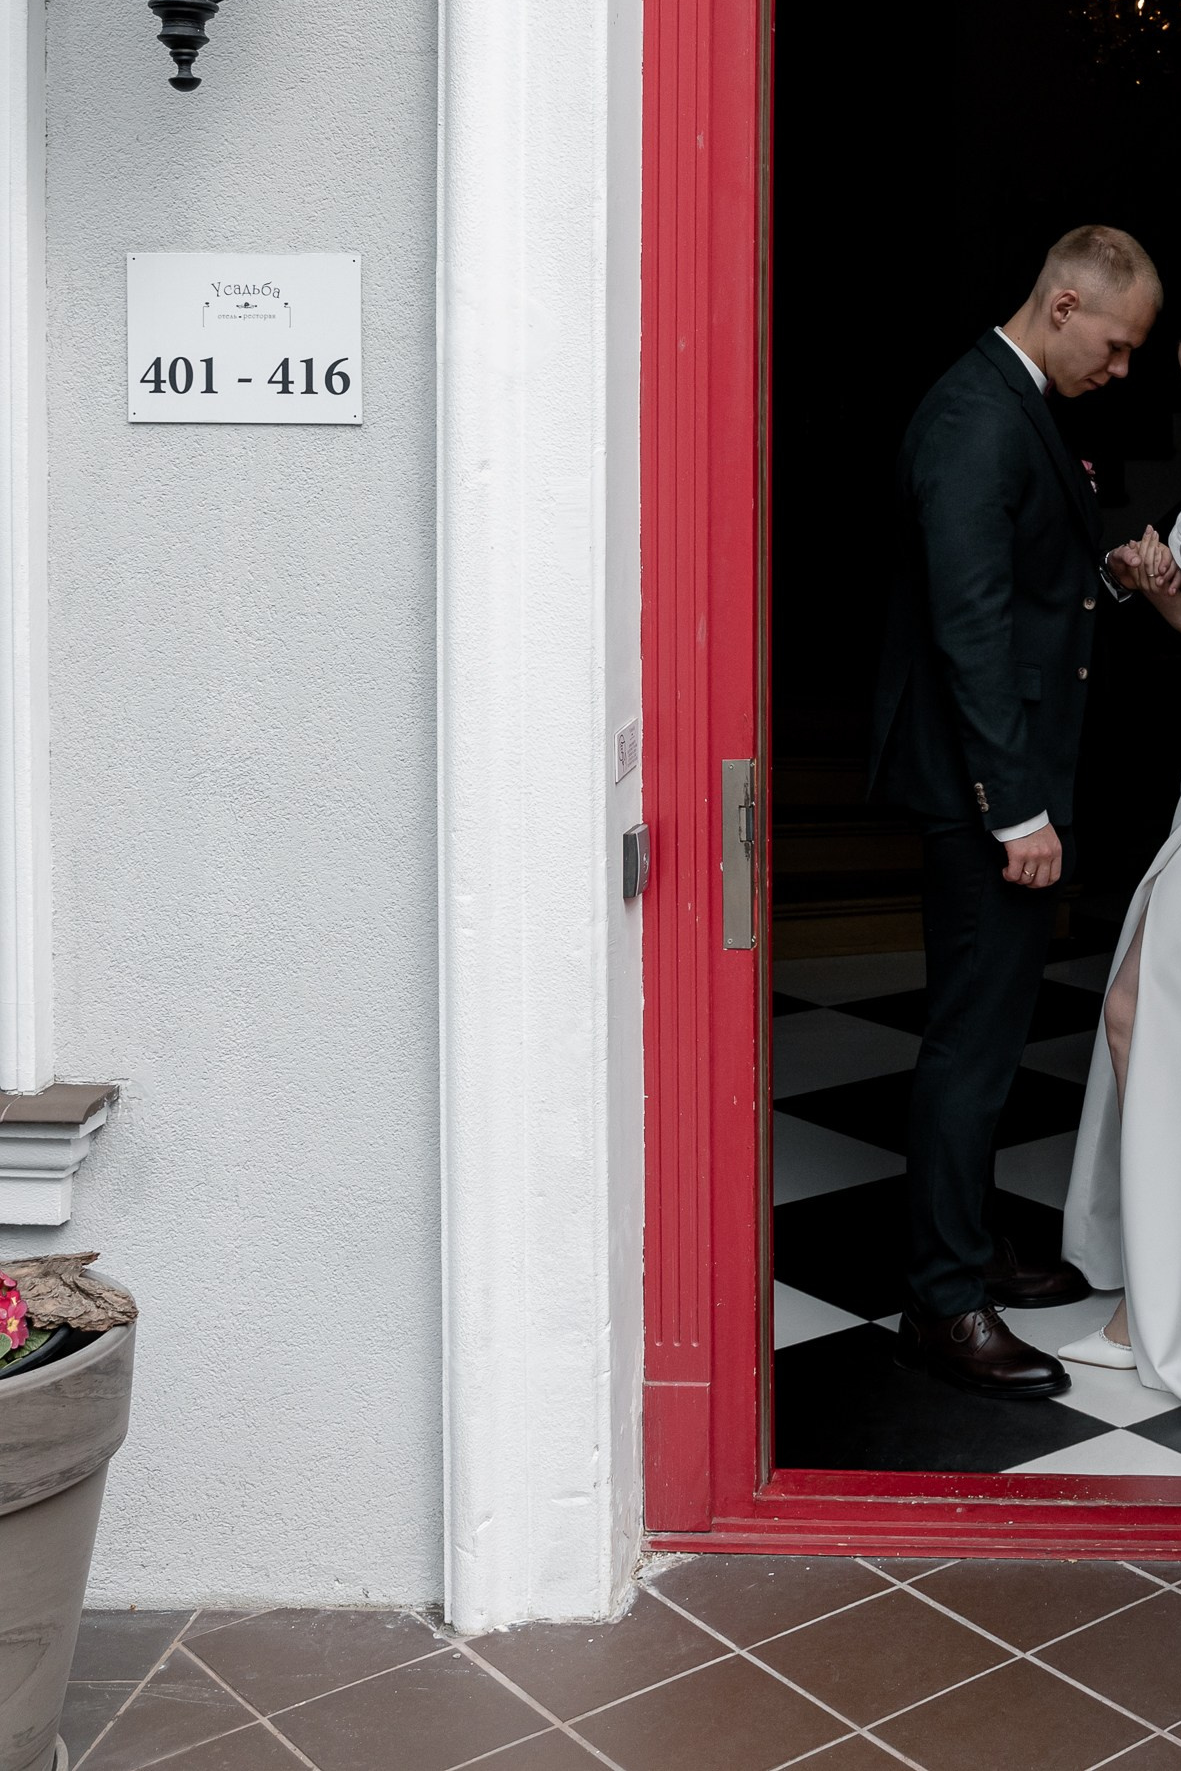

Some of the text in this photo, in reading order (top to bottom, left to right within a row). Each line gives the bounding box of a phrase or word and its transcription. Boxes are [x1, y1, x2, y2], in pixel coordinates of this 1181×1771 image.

[211, 281, 281, 299] Усадьба
[140, 356, 218, 394] 401
[267, 357, 351, 395] 416
